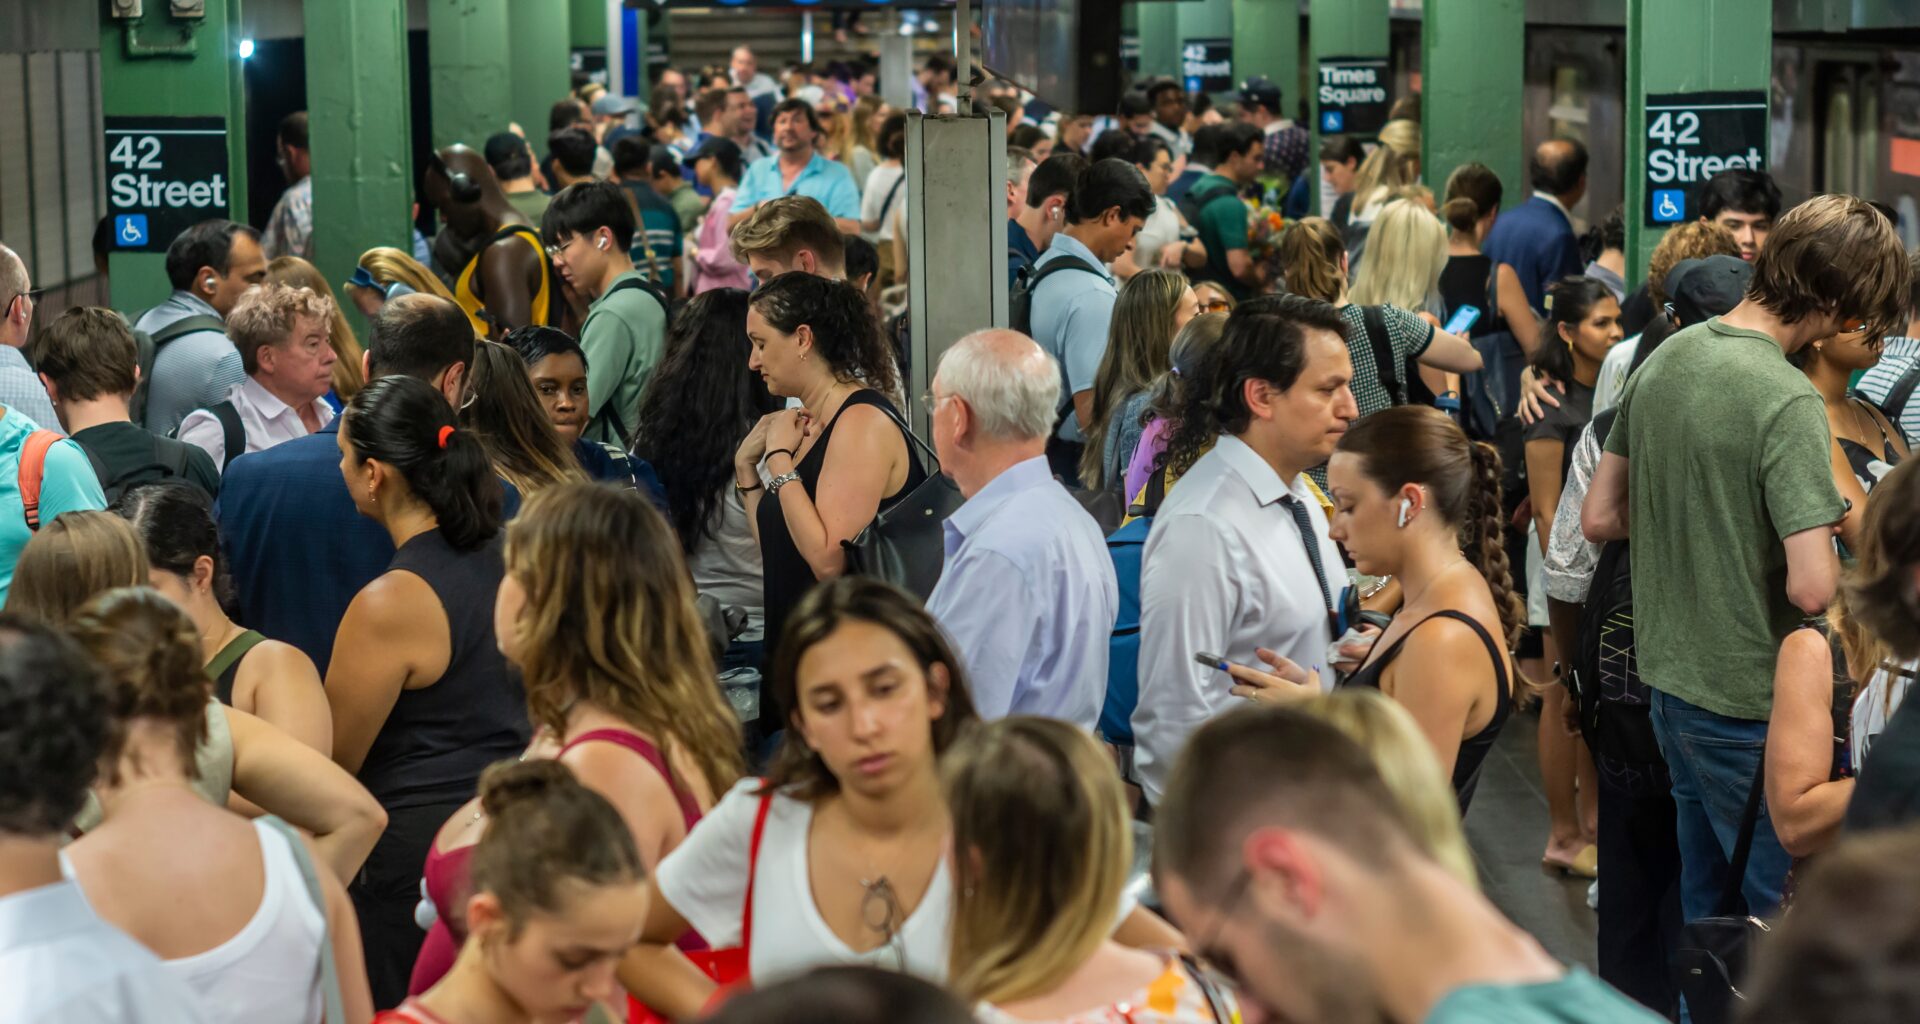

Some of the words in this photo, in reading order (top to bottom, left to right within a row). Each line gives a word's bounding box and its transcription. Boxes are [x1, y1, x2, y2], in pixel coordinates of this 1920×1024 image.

[1320, 67, 1376, 84] Times
[1320, 86, 1386, 106] Square
[1649, 112, 1700, 145] 42
[110, 136, 162, 169] 42
[111, 173, 226, 207] Street
